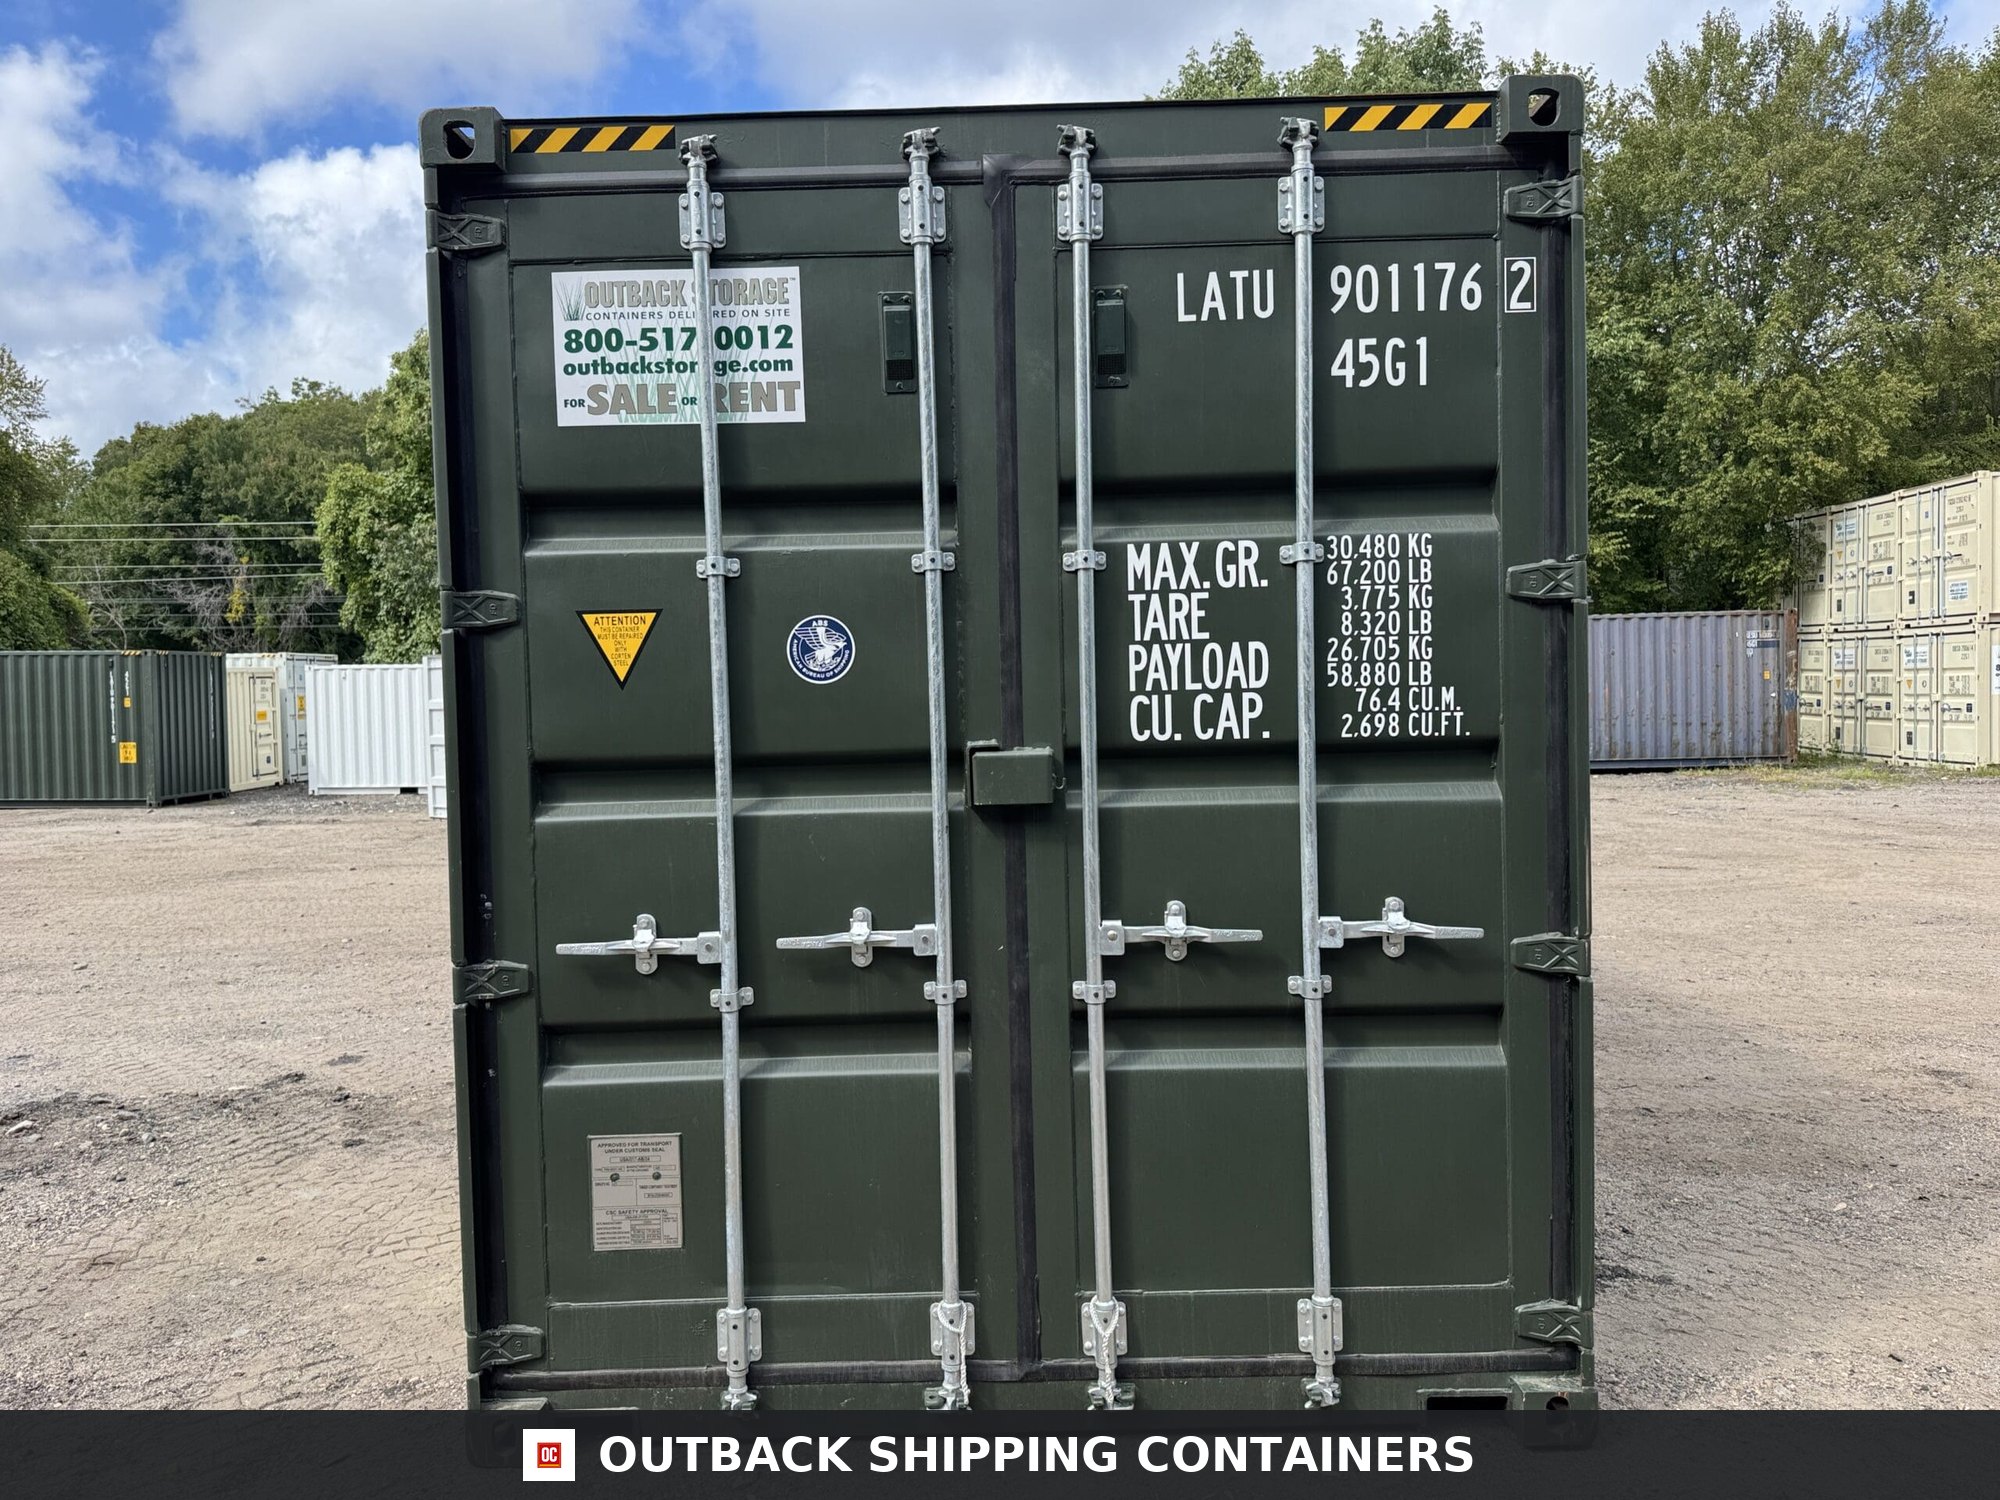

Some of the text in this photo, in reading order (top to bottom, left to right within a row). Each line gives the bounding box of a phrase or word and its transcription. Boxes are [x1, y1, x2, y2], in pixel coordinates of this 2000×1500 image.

[584, 280, 687, 308] OUTBACK
[1176, 260, 1532, 322] LATU 901176 2
[585, 308, 790, 321] CONTAINERS DELIRED ON SITE
[563, 324, 793, 353] 800-5170012
[563, 356, 793, 377] outbackstorge.com
[1330, 336, 1428, 388] 45G1
[564, 399, 585, 408] FOR
[586, 383, 678, 415] SALE
[681, 396, 697, 406] OR
[1327, 533, 1432, 559] 30,480 KG
[1327, 559, 1432, 585] 67,200 LB
[1341, 584, 1432, 610] 3,775 KG
[594, 615, 646, 626] ATTENTION
[812, 619, 828, 627] ABS
[1128, 592, 1210, 641] TARE
[1341, 610, 1432, 636] 8,320 LB
[619, 632, 643, 640] REPAIRED
[1327, 635, 1432, 661] 26,705 KG
[1128, 641, 1270, 692] PAYLOAD
[1327, 661, 1432, 687] 58,880 LB
[1355, 687, 1400, 712] 76.4
[1130, 692, 1270, 741] CU. CAP.
[1341, 713, 1400, 738] 2,698
